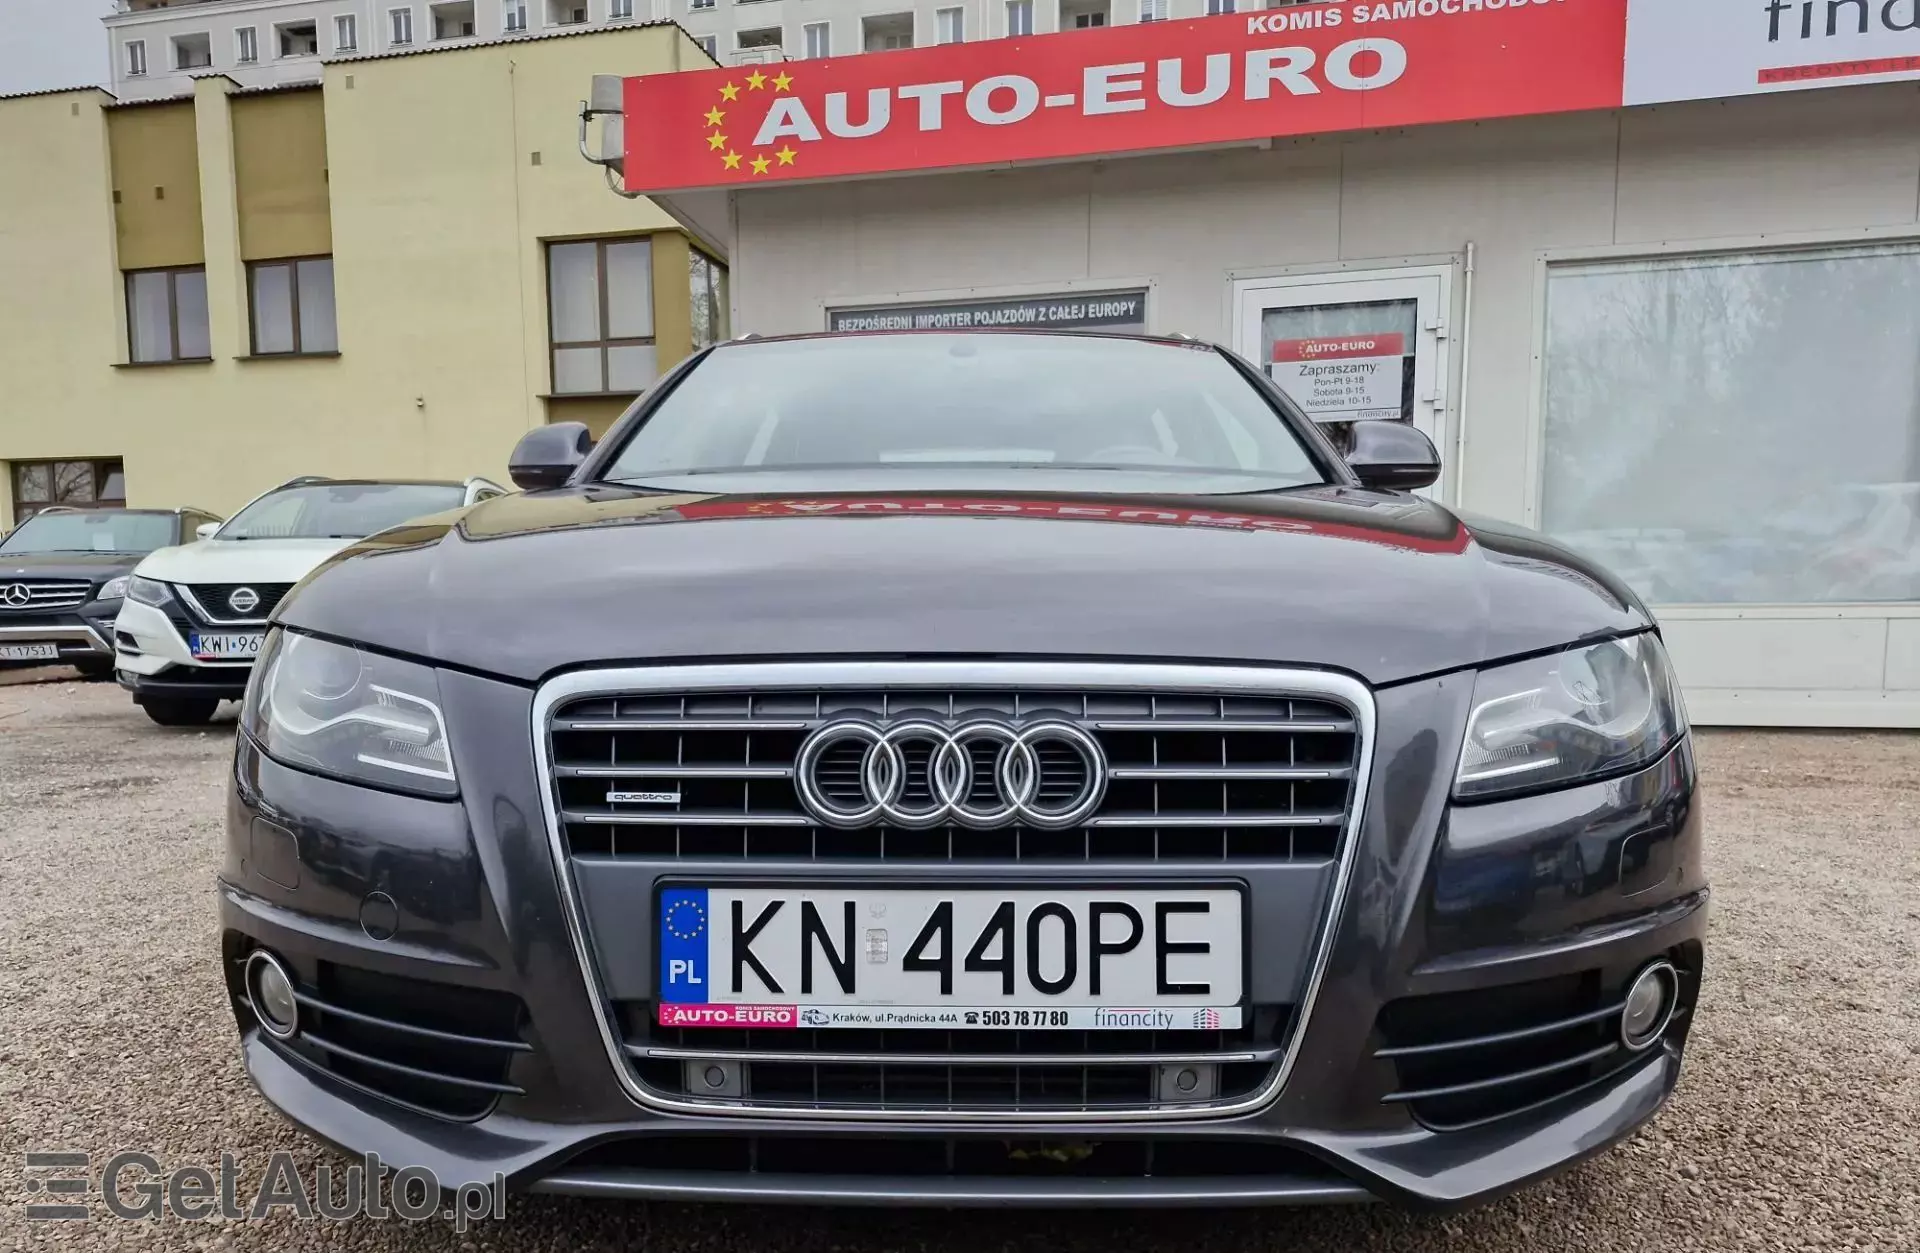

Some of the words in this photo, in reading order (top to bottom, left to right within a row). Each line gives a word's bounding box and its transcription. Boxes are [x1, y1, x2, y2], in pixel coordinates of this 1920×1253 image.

[1247, 8, 1343, 35] KOMIS
[752, 37, 1407, 147] AUTO-EURO
[837, 314, 912, 332] BEZPOŚREDNI
[915, 311, 972, 329] IMPORTER
[974, 305, 1036, 326] POJAZDÓW
[1038, 307, 1047, 322] Z
[1049, 304, 1085, 321] CAŁEJ
[1088, 301, 1136, 318] EUROPY
[1306, 340, 1376, 353] AUTO-EURO
[1314, 377, 1343, 386] Pon-Pt
[1345, 376, 1364, 385] 9-18
[1313, 388, 1343, 397] Sobota
[1345, 386, 1365, 395] 9-15
[1306, 398, 1345, 407] Niedziela
[1348, 396, 1372, 405] 10-15
[200, 636, 229, 653] KWI
[614, 793, 673, 801] quattro
[731, 899, 856, 995] KN
[902, 900, 1211, 996] 440PE
[669, 960, 702, 984] PL
[673, 1010, 791, 1023] AUTO-EURO
[832, 1013, 872, 1024] Kraków,
[938, 1014, 958, 1023] 44A
[982, 1010, 1010, 1026] 503
[1013, 1010, 1030, 1026] 78
[1032, 1010, 1047, 1026] 77
[1050, 1010, 1069, 1026] 80
[1094, 1008, 1174, 1031] financity
